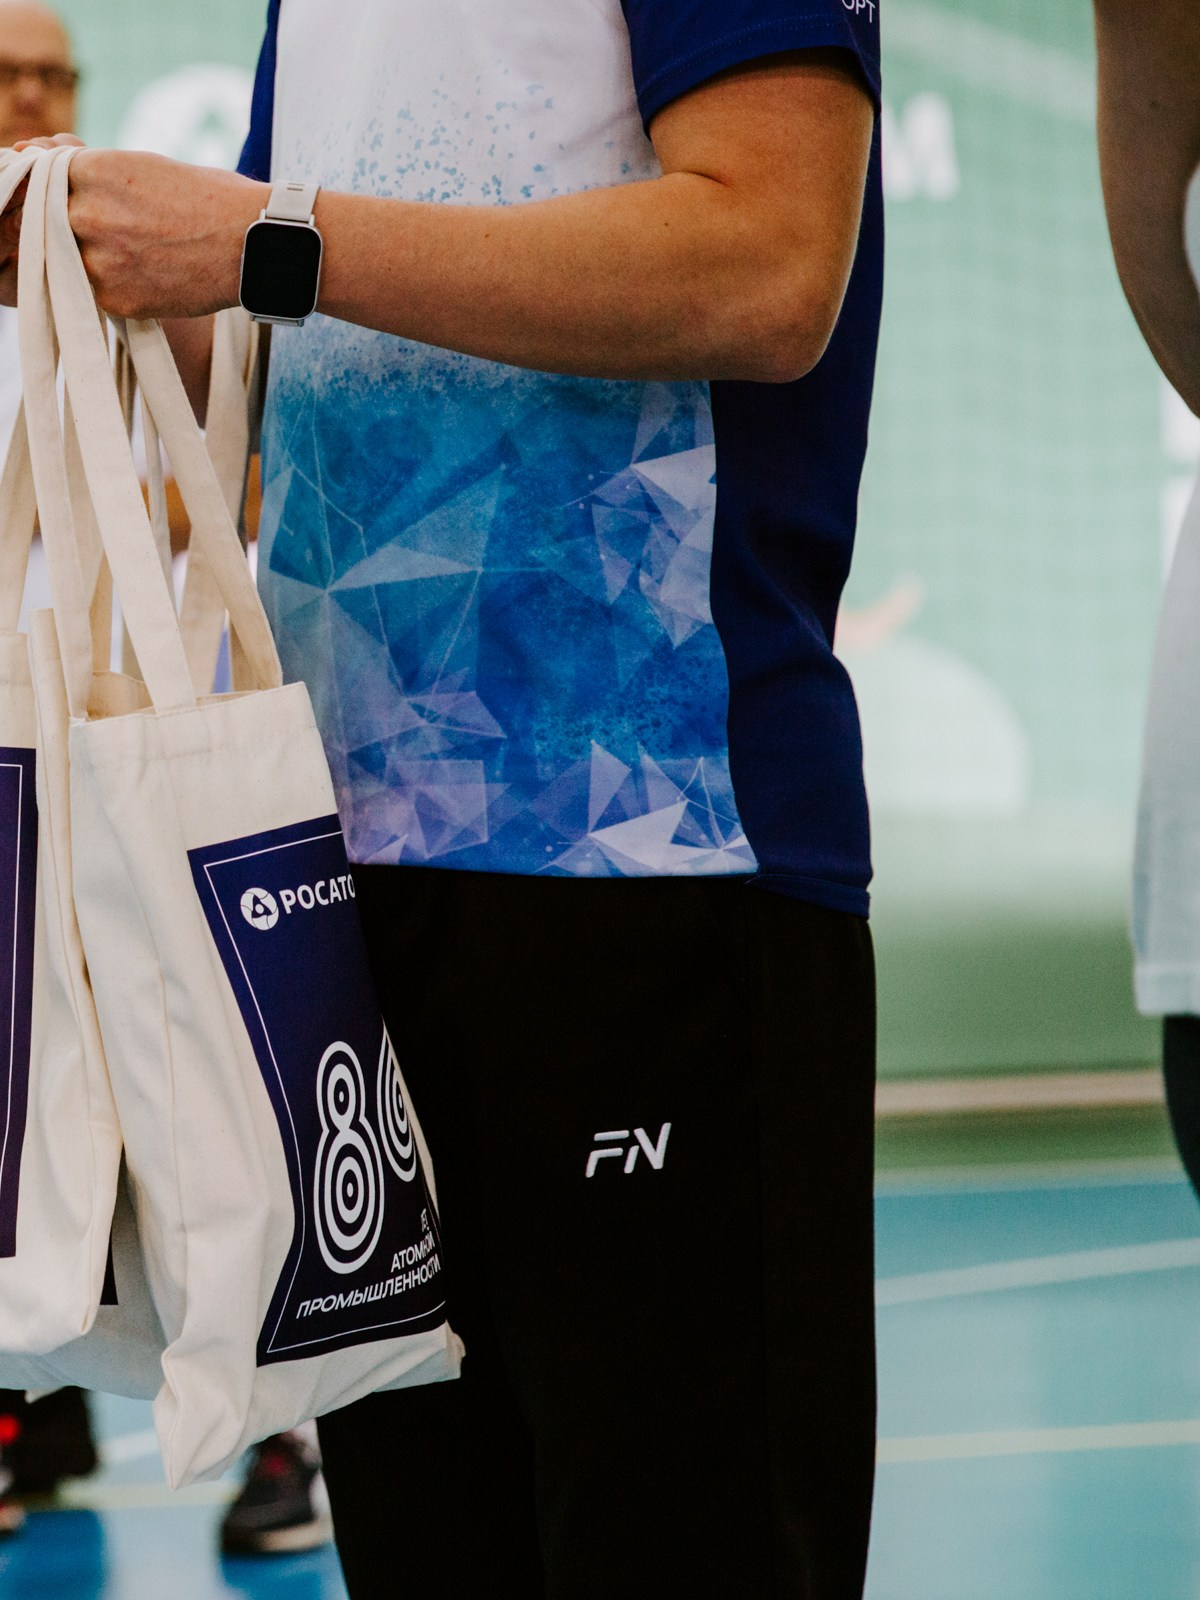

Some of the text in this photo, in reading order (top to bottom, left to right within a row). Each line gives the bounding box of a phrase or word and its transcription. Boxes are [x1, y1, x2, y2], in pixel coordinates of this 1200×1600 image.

[842, 0, 876, 23] ОРТ
[279, 873, 356, 914] РОСАТО
[585, 1122, 672, 1178] FN
[296, 1253, 442, 1319] ПРОМЫШЛЕННОСТИ
